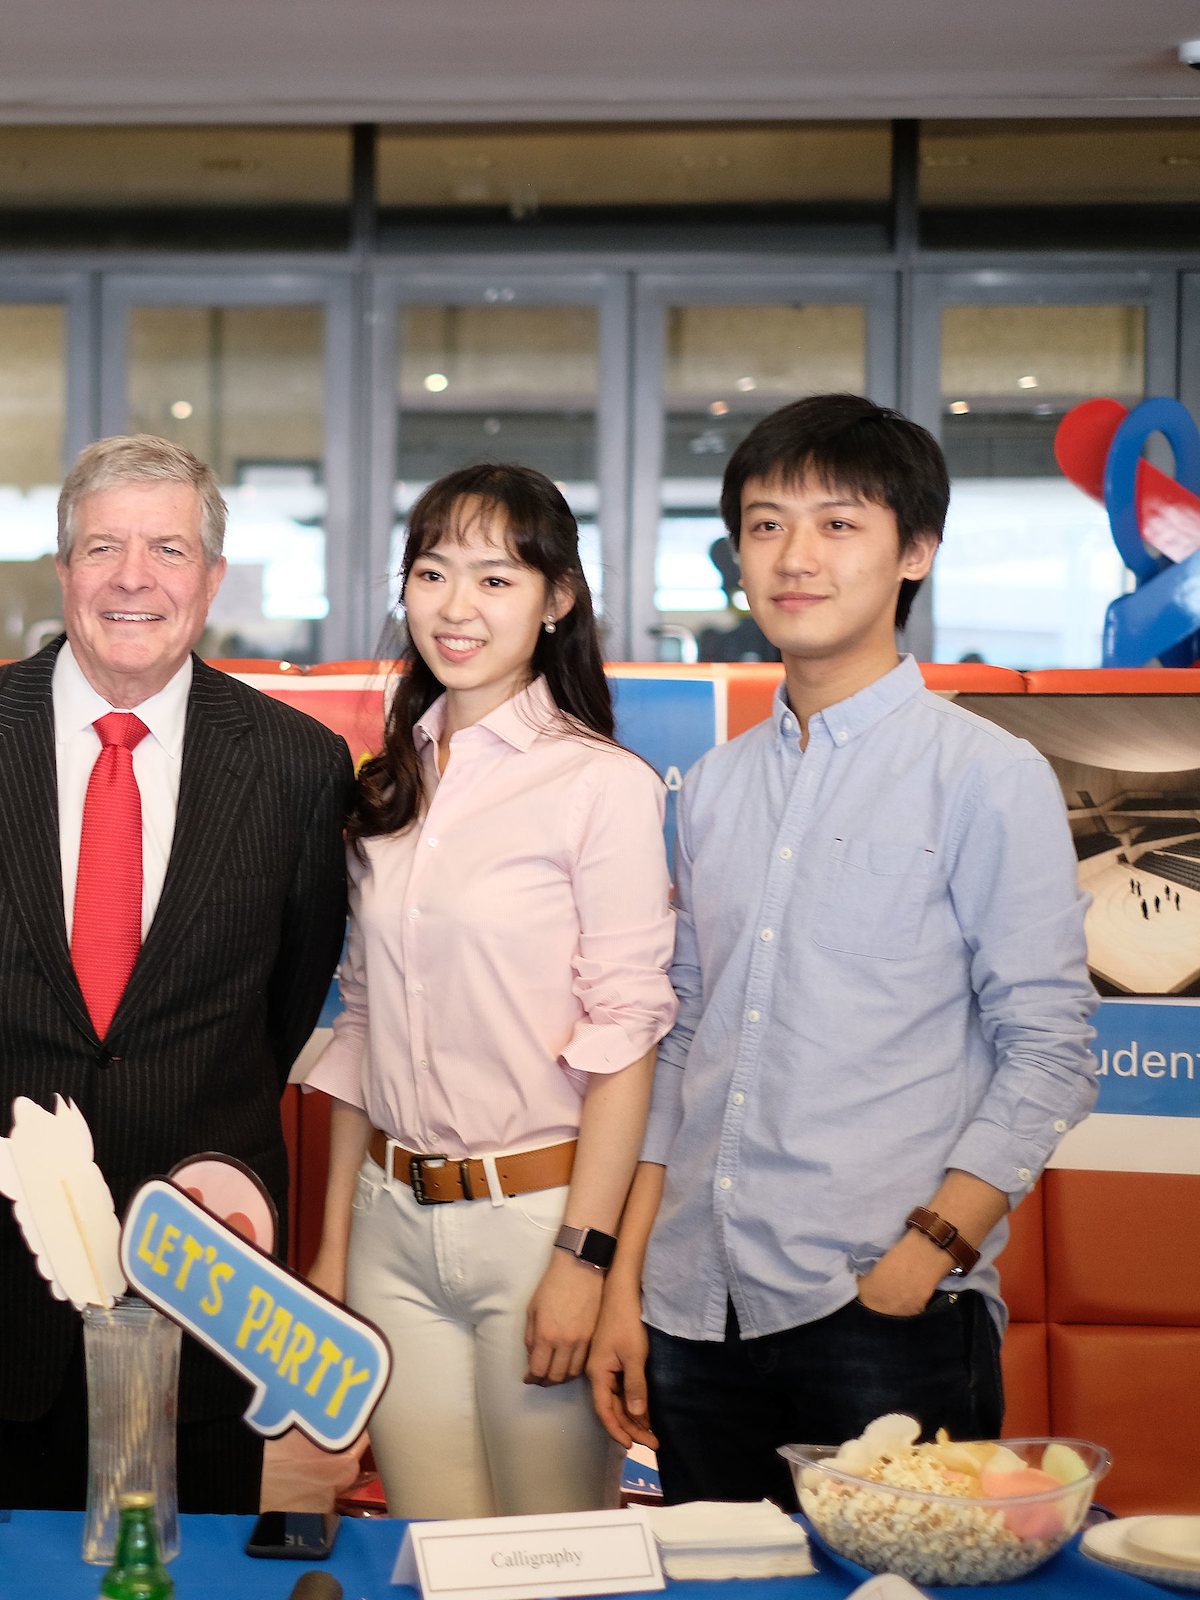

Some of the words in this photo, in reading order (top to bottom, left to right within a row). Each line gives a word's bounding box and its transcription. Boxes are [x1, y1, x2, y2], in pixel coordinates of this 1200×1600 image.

[1087, 1040, 1200, 1080] uden
[137, 1212, 236, 1316] LET'S
[235, 1285, 370, 1419] PARTY
[491, 1547, 583, 1570] Calligraphy
